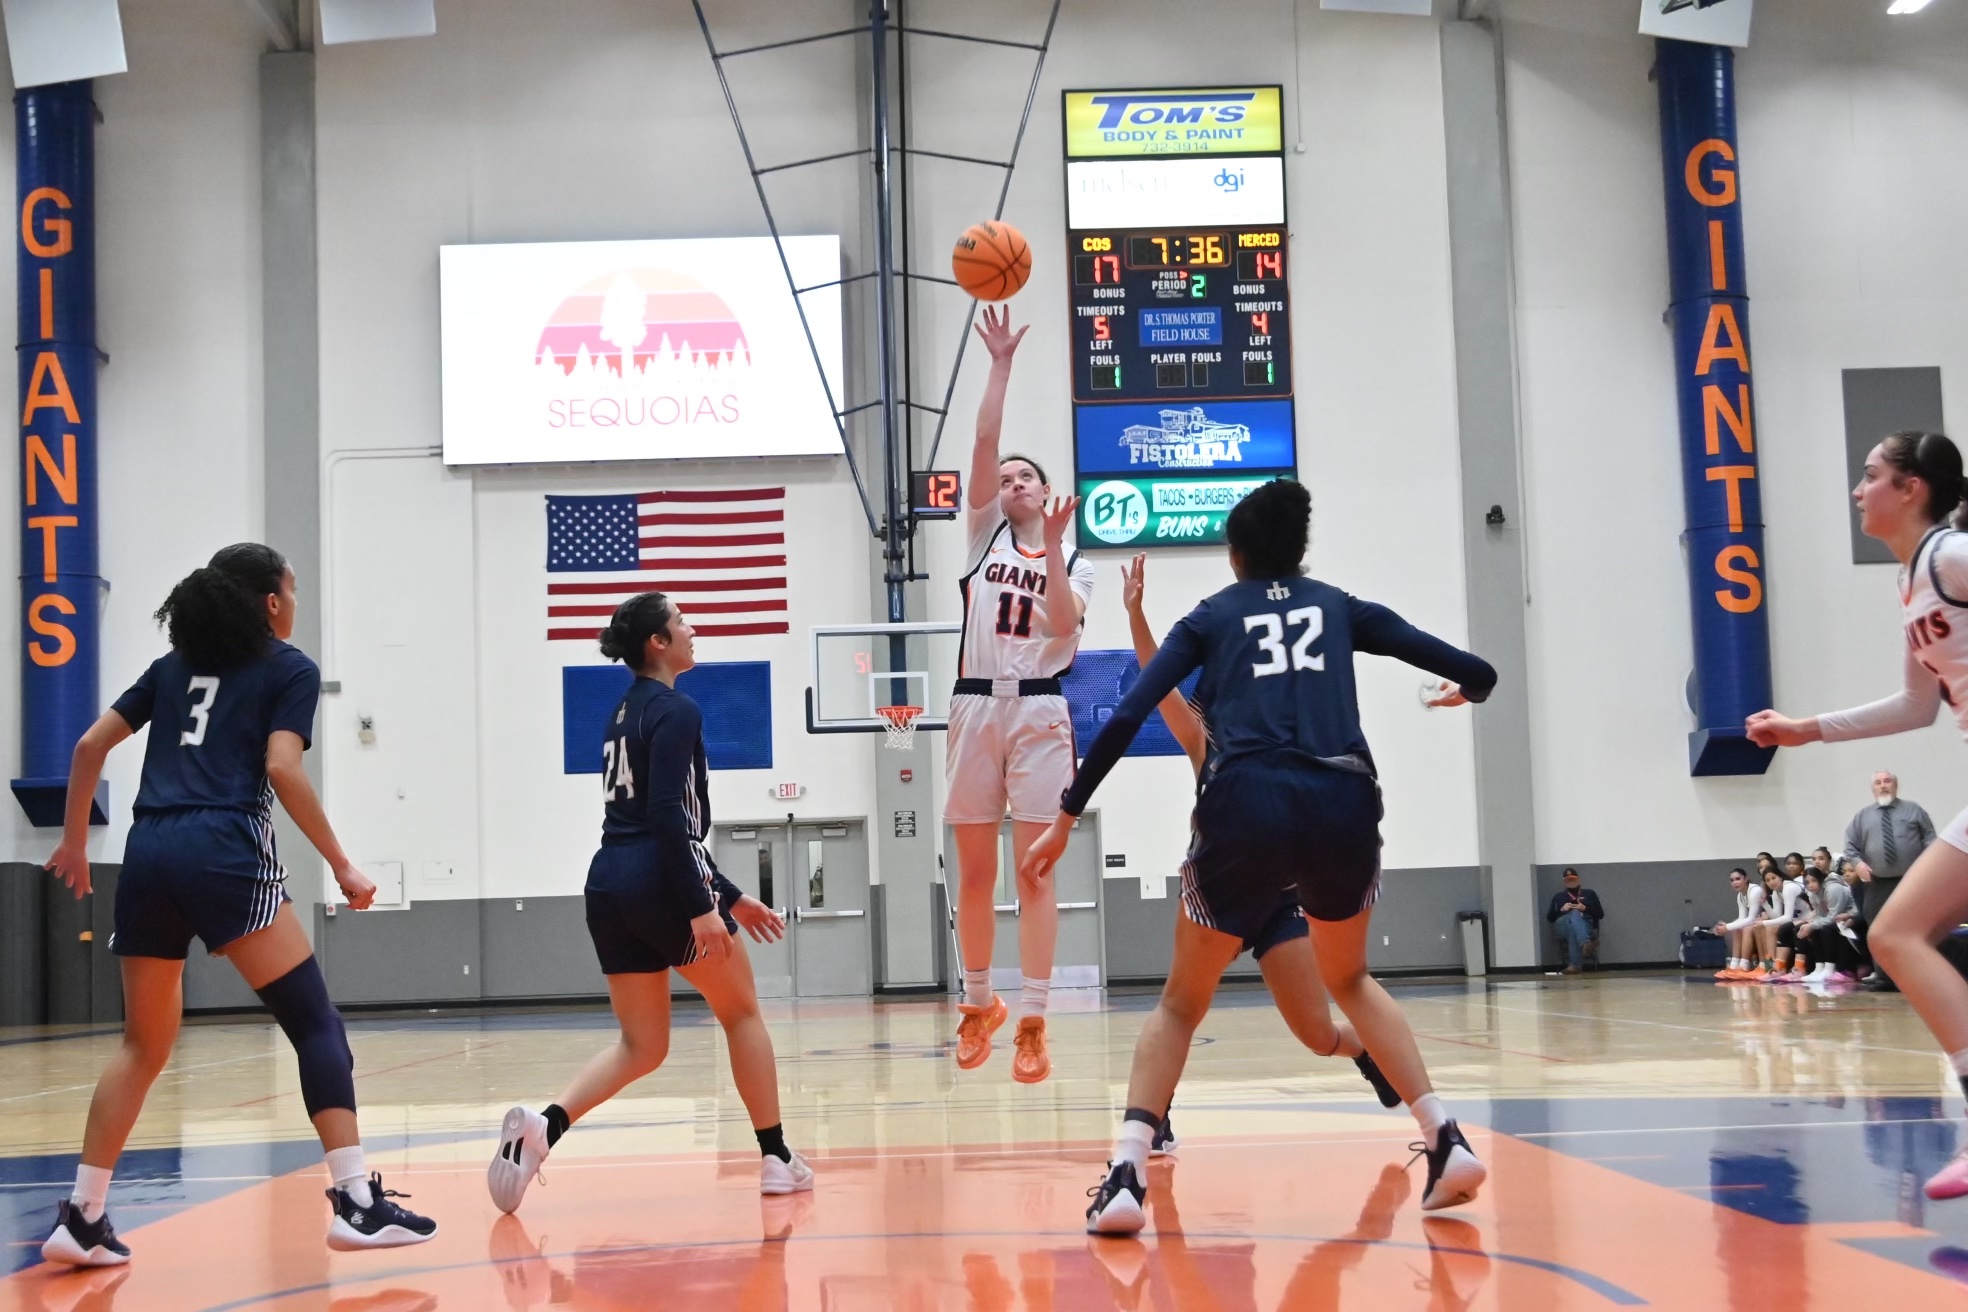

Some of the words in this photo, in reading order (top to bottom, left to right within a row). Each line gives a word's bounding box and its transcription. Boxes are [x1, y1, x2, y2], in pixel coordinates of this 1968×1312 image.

[1091, 92, 1256, 129] TOM'S
[1103, 131, 1157, 142] BODY
[1165, 130, 1178, 141] &
[1186, 128, 1245, 140] PAINT
[1142, 141, 1209, 153] 732-3914
[1214, 168, 1244, 193] dgi
[1083, 237, 1111, 252] COS
[1151, 236, 1223, 265] 7:36
[1239, 233, 1280, 247] MERCED
[1094, 255, 1119, 284] 17
[1159, 271, 1178, 280] POSS
[1257, 251, 1281, 279] 14
[1093, 288, 1125, 298] BONUS
[1151, 280, 1187, 291] PERIOD
[1192, 275, 1205, 297] 2
[1233, 284, 1265, 295] BONUS
[1077, 305, 1125, 316] TIMEOUTS
[1235, 301, 1283, 312] TIMEOUTS
[1094, 316, 1110, 340] 5
[1161, 313, 1189, 326] THOMAS
[1190, 312, 1216, 325] PORTER
[1252, 312, 1267, 335] 4
[1090, 340, 1113, 350] LEFT
[1151, 329, 1179, 342] FIELD
[1181, 327, 1211, 341] HOUSE
[1249, 336, 1272, 346] LEFT
[1090, 355, 1120, 365] FOULS
[1150, 353, 1186, 364] PLAYER
[1191, 352, 1222, 362] FOULS
[1243, 350, 1273, 361] FOULS
[1114, 366, 1120, 388] 1
[1267, 362, 1273, 384] 1
[1685, 138, 1762, 614] GIANTS
[549, 394, 739, 428] SEQUOIAS
[22, 187, 82, 667] GIANTS
[1130, 440, 1242, 464] FISTOLERA
[929, 475, 957, 507] 12
[1158, 489, 1185, 506] TACOS
[1194, 487, 1234, 505] BURGERS
[1156, 515, 1208, 538] BUNS
[985, 562, 1047, 597] GIANT
[996, 591, 1033, 638] 11
[1243, 606, 1325, 678] 32
[180, 675, 221, 746] 3
[603, 735, 635, 802] 24
[779, 783, 797, 797] EXIT
